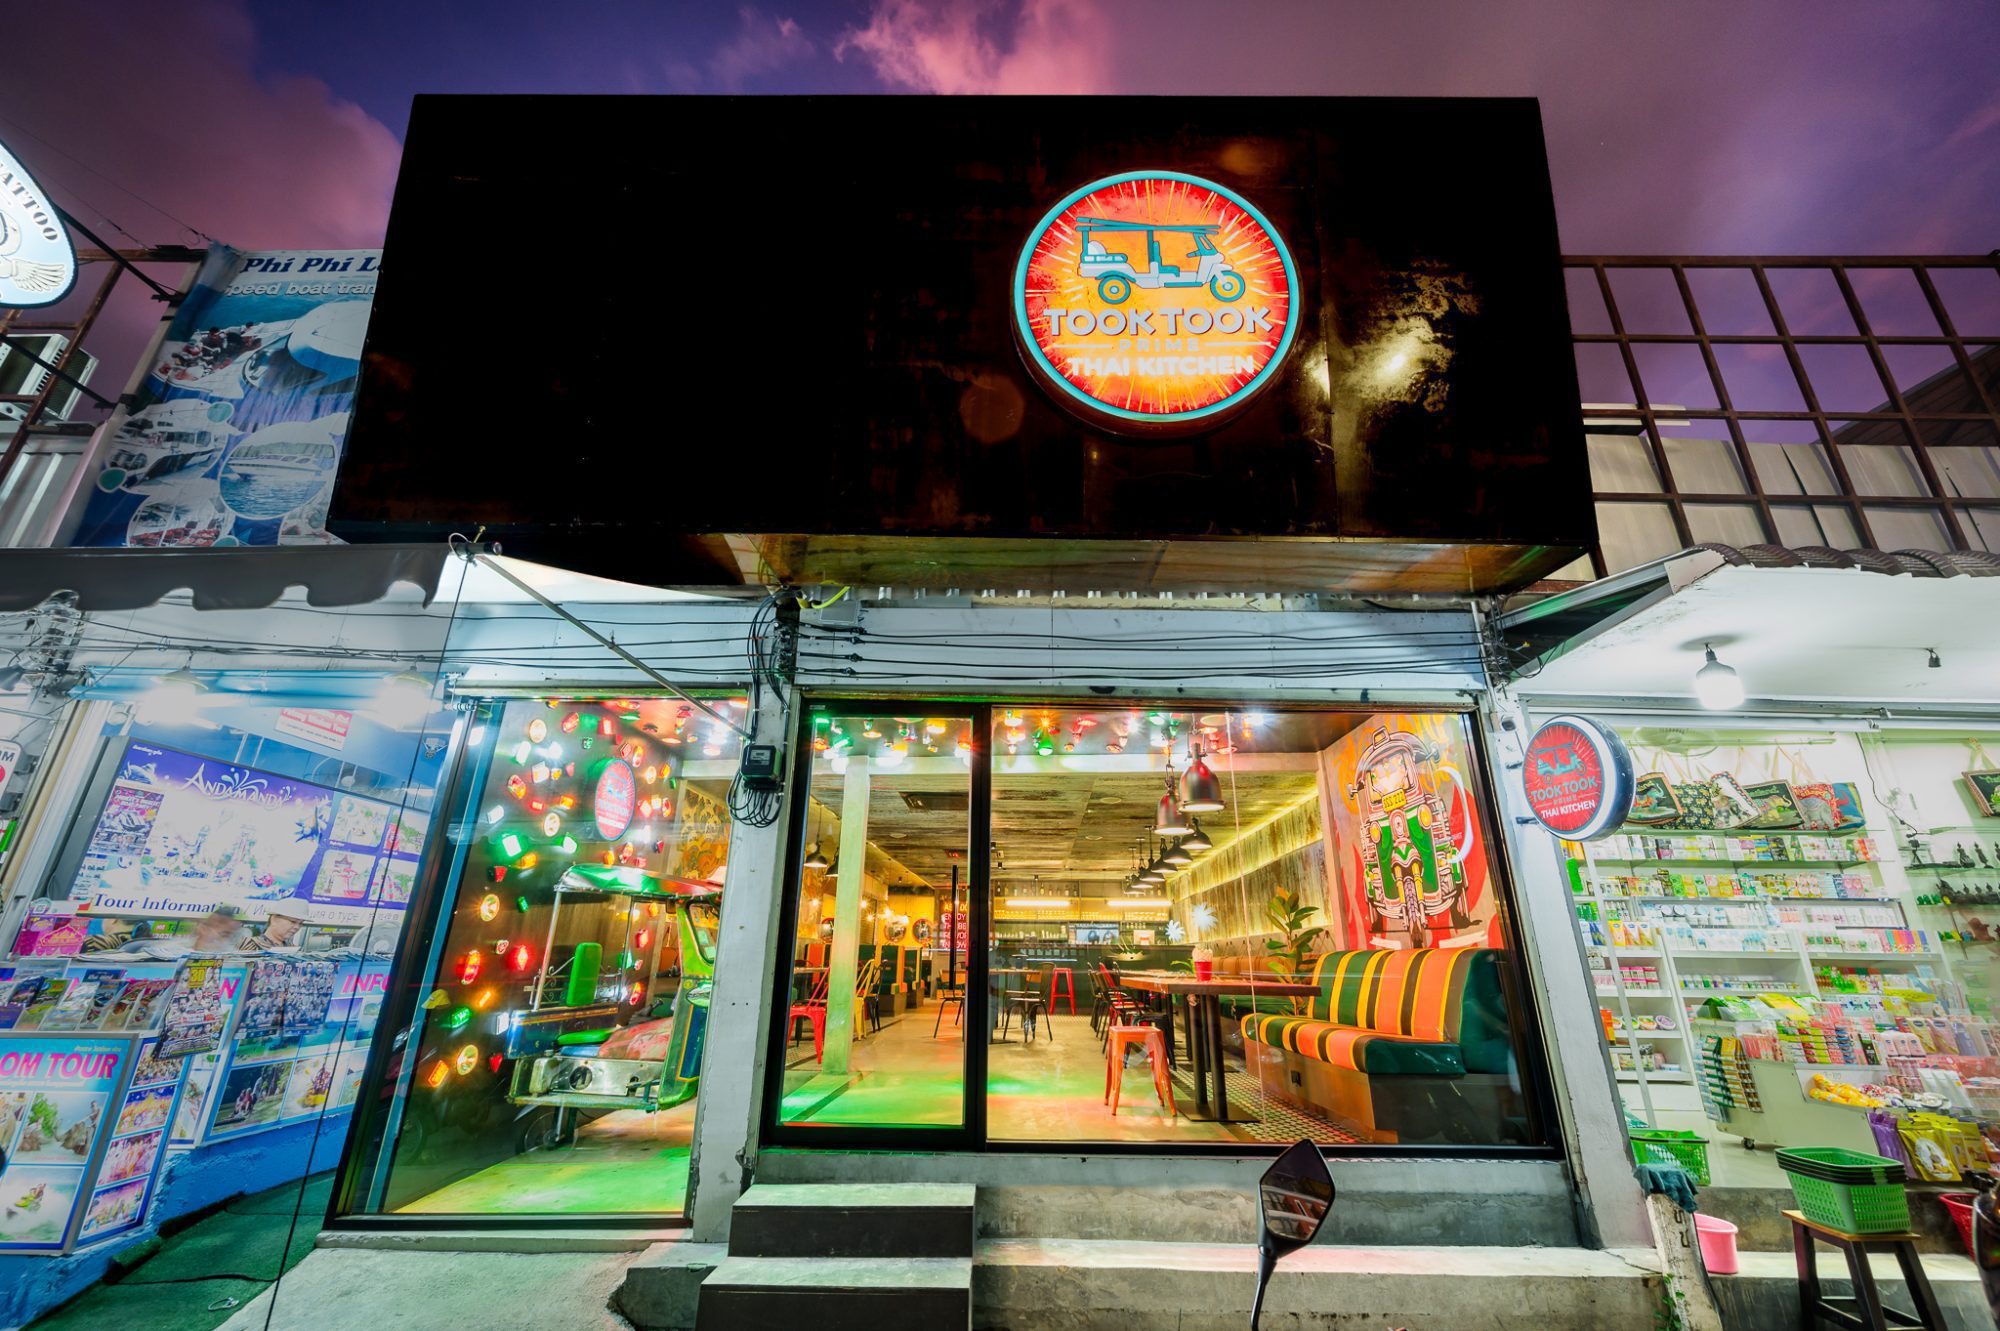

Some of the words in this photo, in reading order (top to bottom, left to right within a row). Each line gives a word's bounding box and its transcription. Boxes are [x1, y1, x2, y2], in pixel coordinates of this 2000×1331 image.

[0, 165, 58, 241] ATTOO
[241, 257, 295, 273] Phi
[298, 257, 355, 273] Phi
[356, 256, 381, 272] L
[286, 283, 331, 295] boat
[1043, 308, 1155, 336] TOOK
[1160, 306, 1273, 335] TOOK
[1119, 338, 1200, 353] PRIME
[1068, 356, 1129, 377] THAI
[1138, 355, 1254, 377] KITCHEN
[0, 750, 15, 762] M
[1531, 784, 1562, 803] TOOK
[1563, 775, 1598, 794] TOOK
[1541, 807, 1559, 819] THAI
[1560, 799, 1596, 815] KITCHEN
[1553, 794, 1577, 805] PRIME
[93, 893, 137, 908] Tour
[142, 897, 240, 914] Informatin
[944, 913, 966, 921] ENOY
[47, 1053, 118, 1079] TOUR
